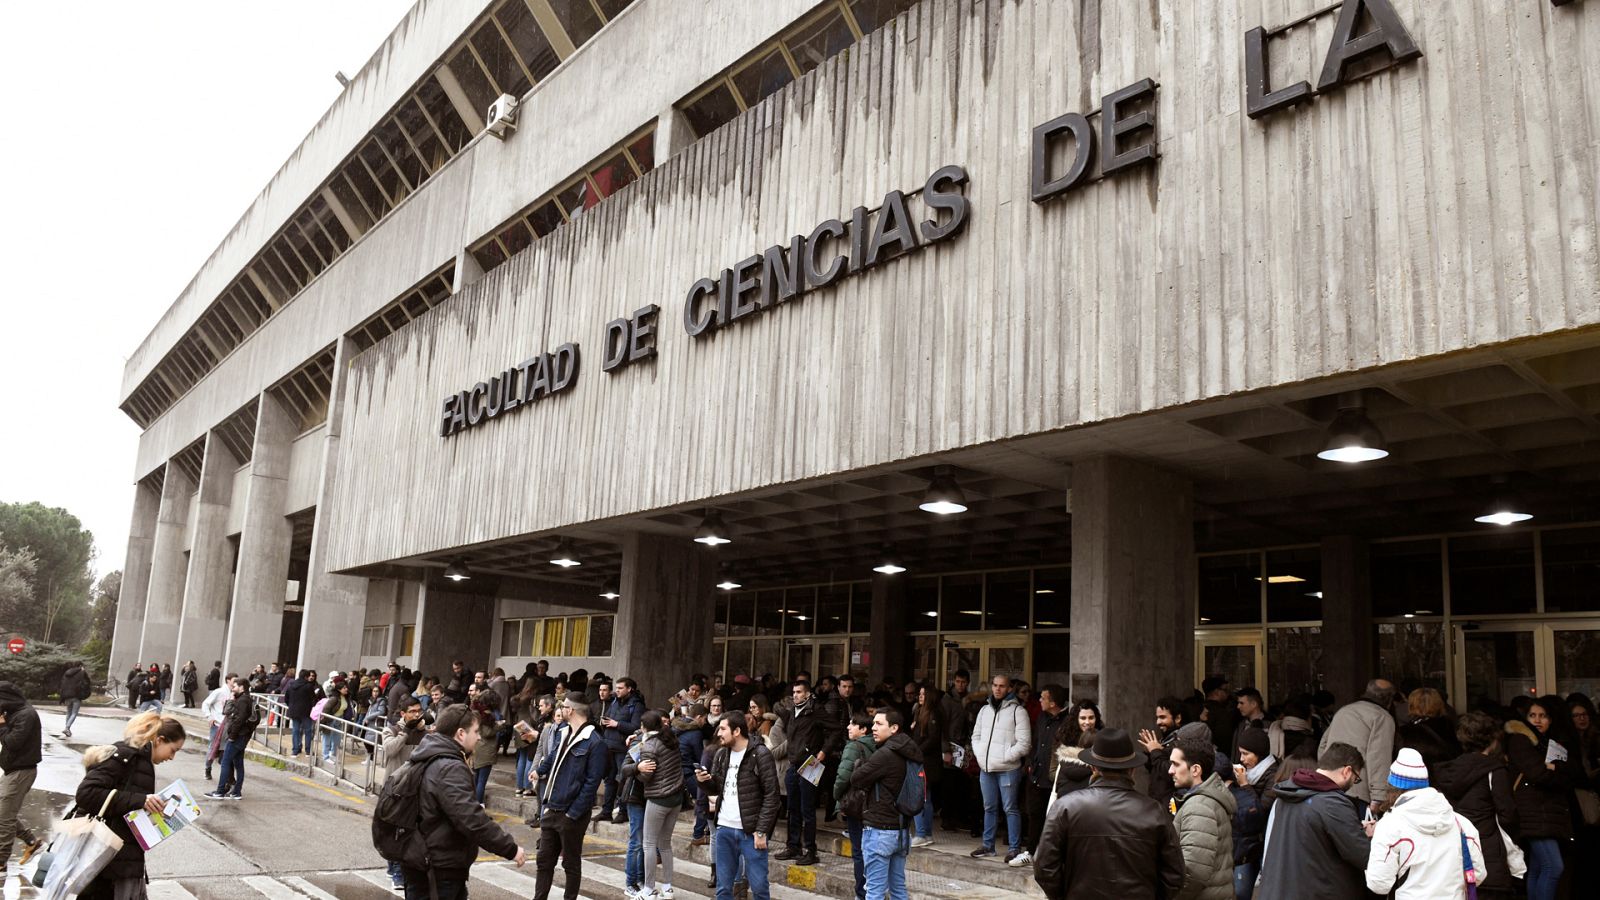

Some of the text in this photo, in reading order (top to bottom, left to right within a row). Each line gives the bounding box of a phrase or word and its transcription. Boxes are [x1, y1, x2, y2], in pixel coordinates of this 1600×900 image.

[441, 0, 1423, 437] FACULTAD DE CIENCIAS DE LA
